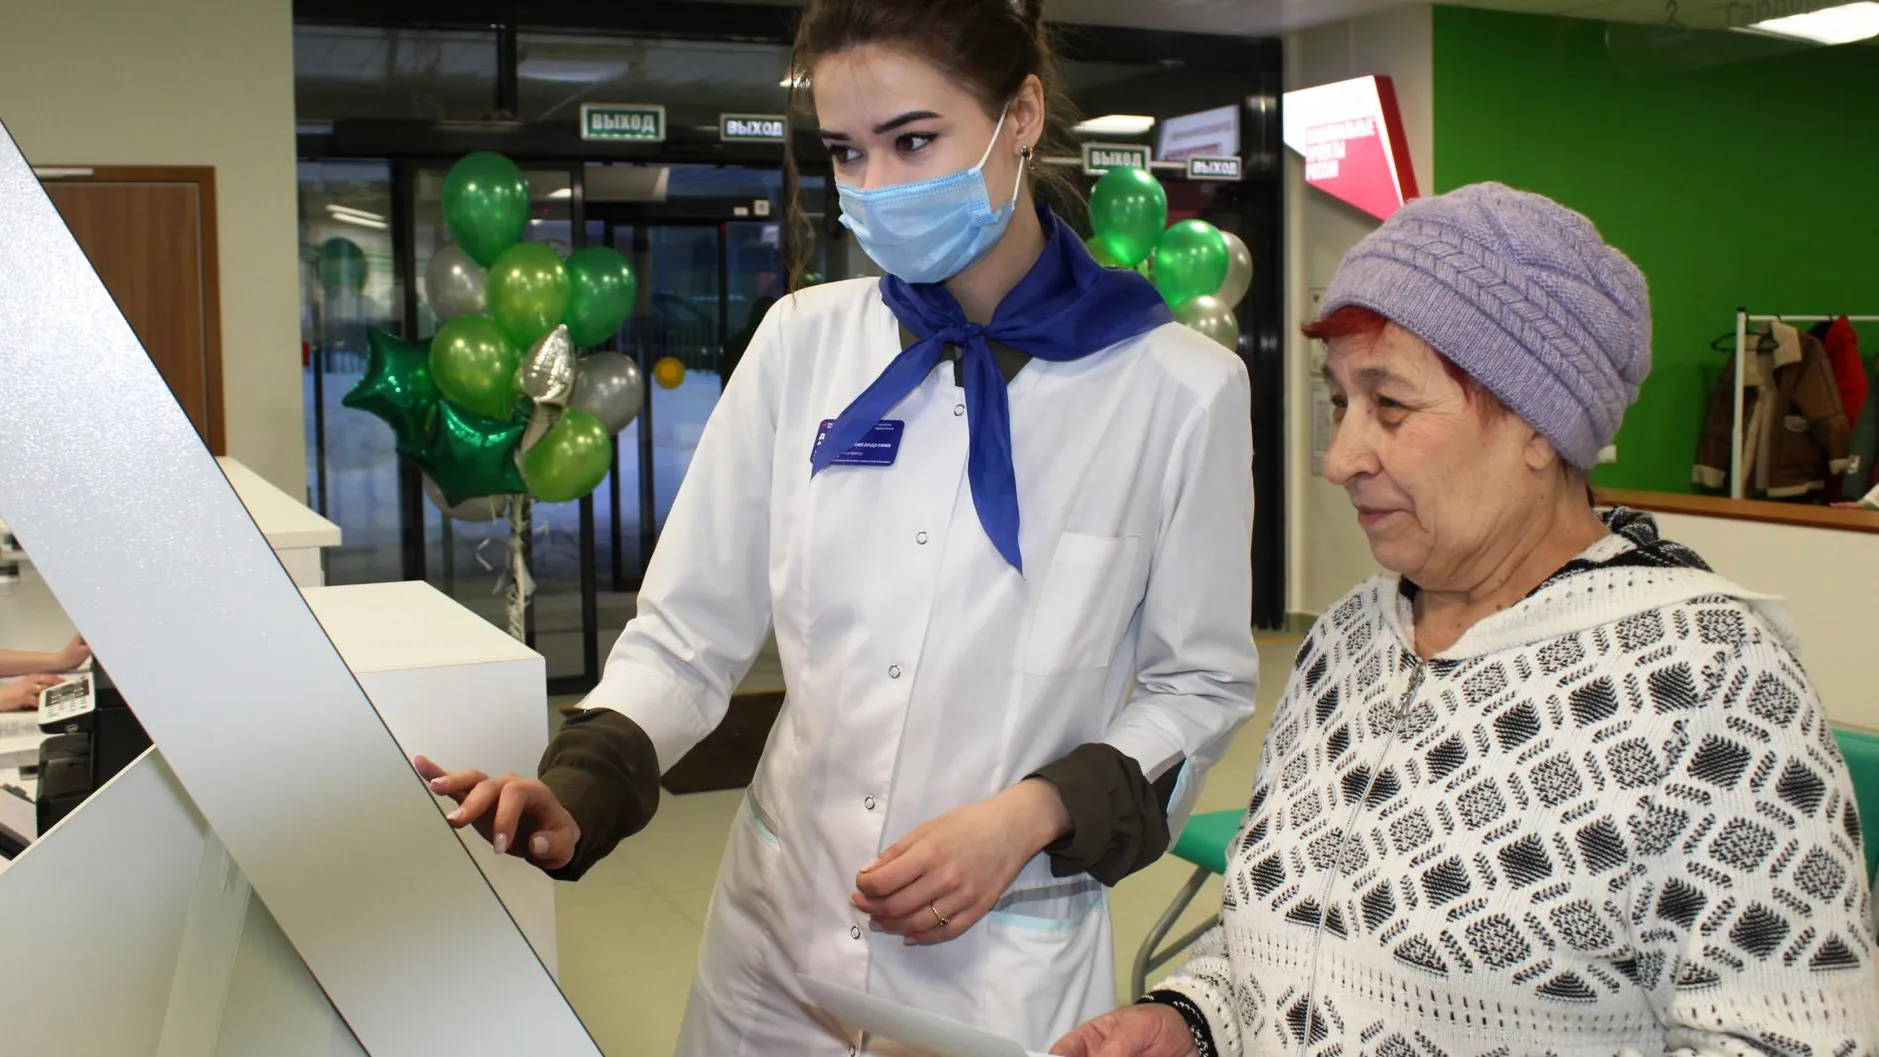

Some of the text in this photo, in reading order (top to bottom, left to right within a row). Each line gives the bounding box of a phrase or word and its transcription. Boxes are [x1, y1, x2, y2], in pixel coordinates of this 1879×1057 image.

[591, 113, 656, 133] ВЫХОД
[727, 120, 783, 137] ВЫХОД
[1091, 151, 1142, 167] ВЫХОД
[1193, 161, 1238, 175] ВЫХОД
